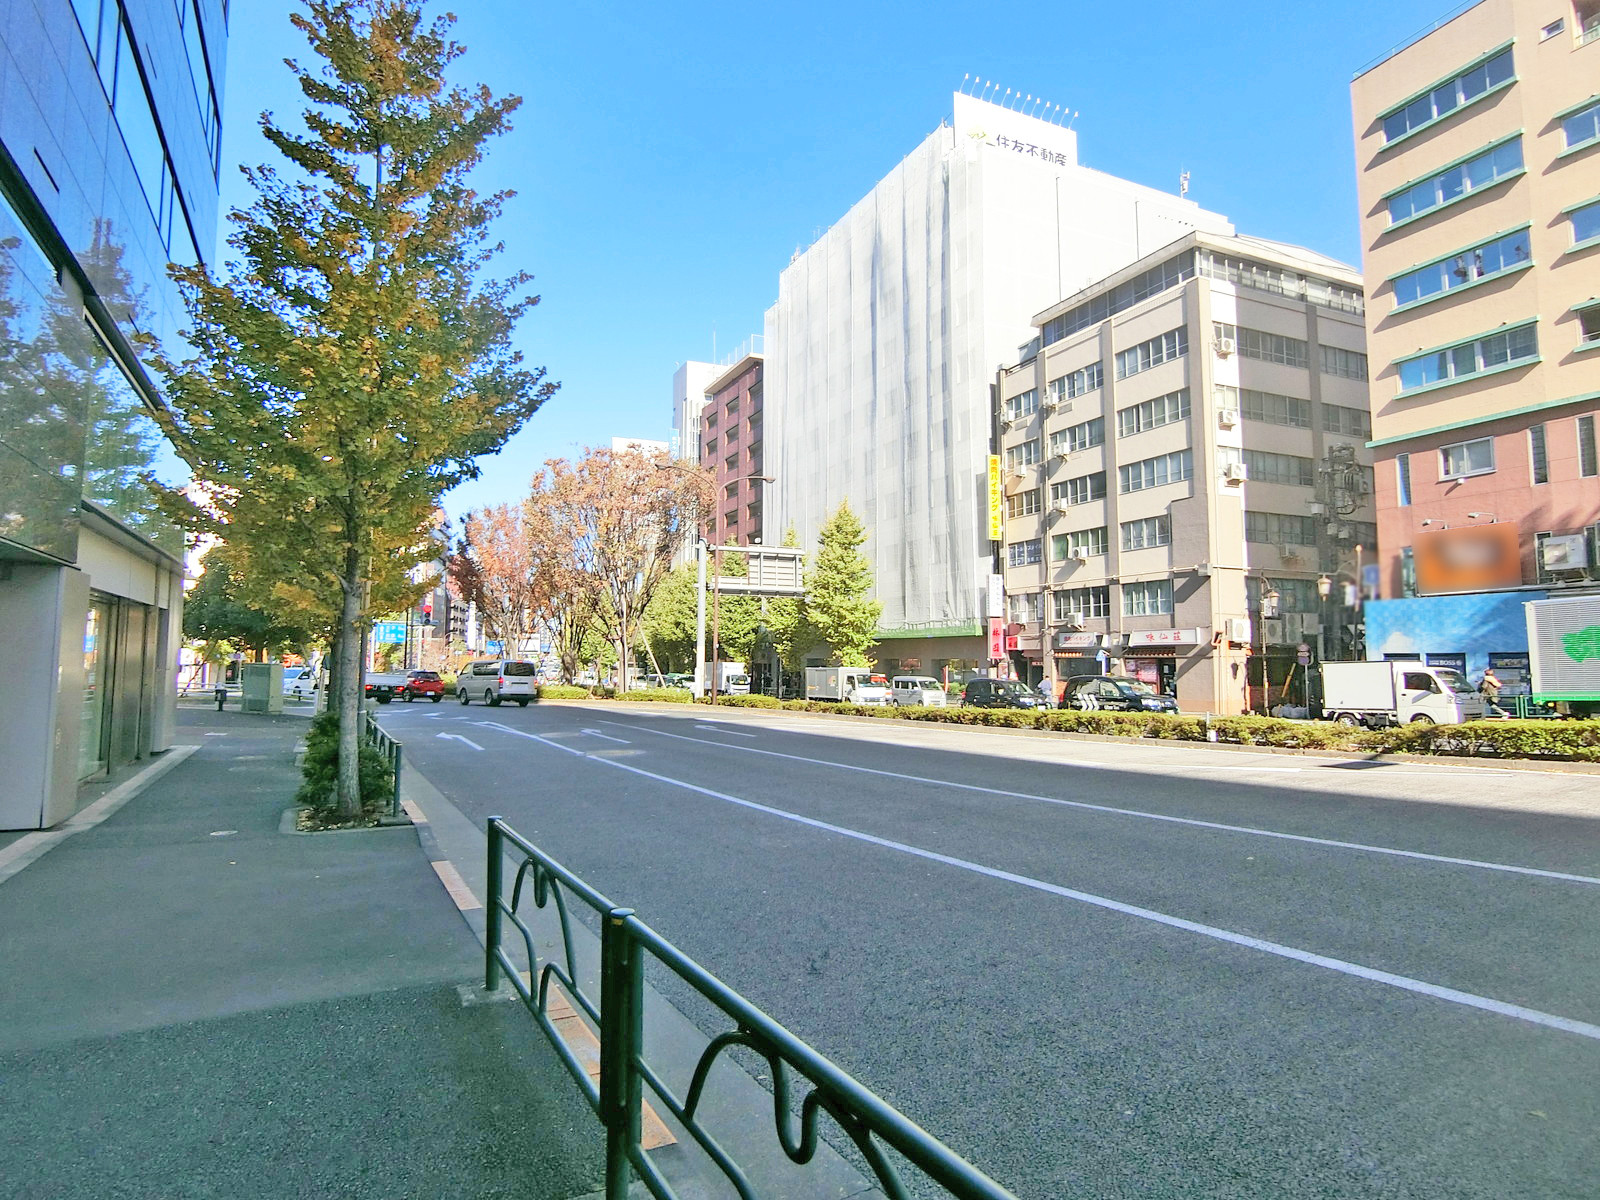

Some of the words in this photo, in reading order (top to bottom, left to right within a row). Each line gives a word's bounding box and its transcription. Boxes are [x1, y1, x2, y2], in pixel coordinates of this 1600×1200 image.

[996, 134, 1067, 167] 住友不動産
